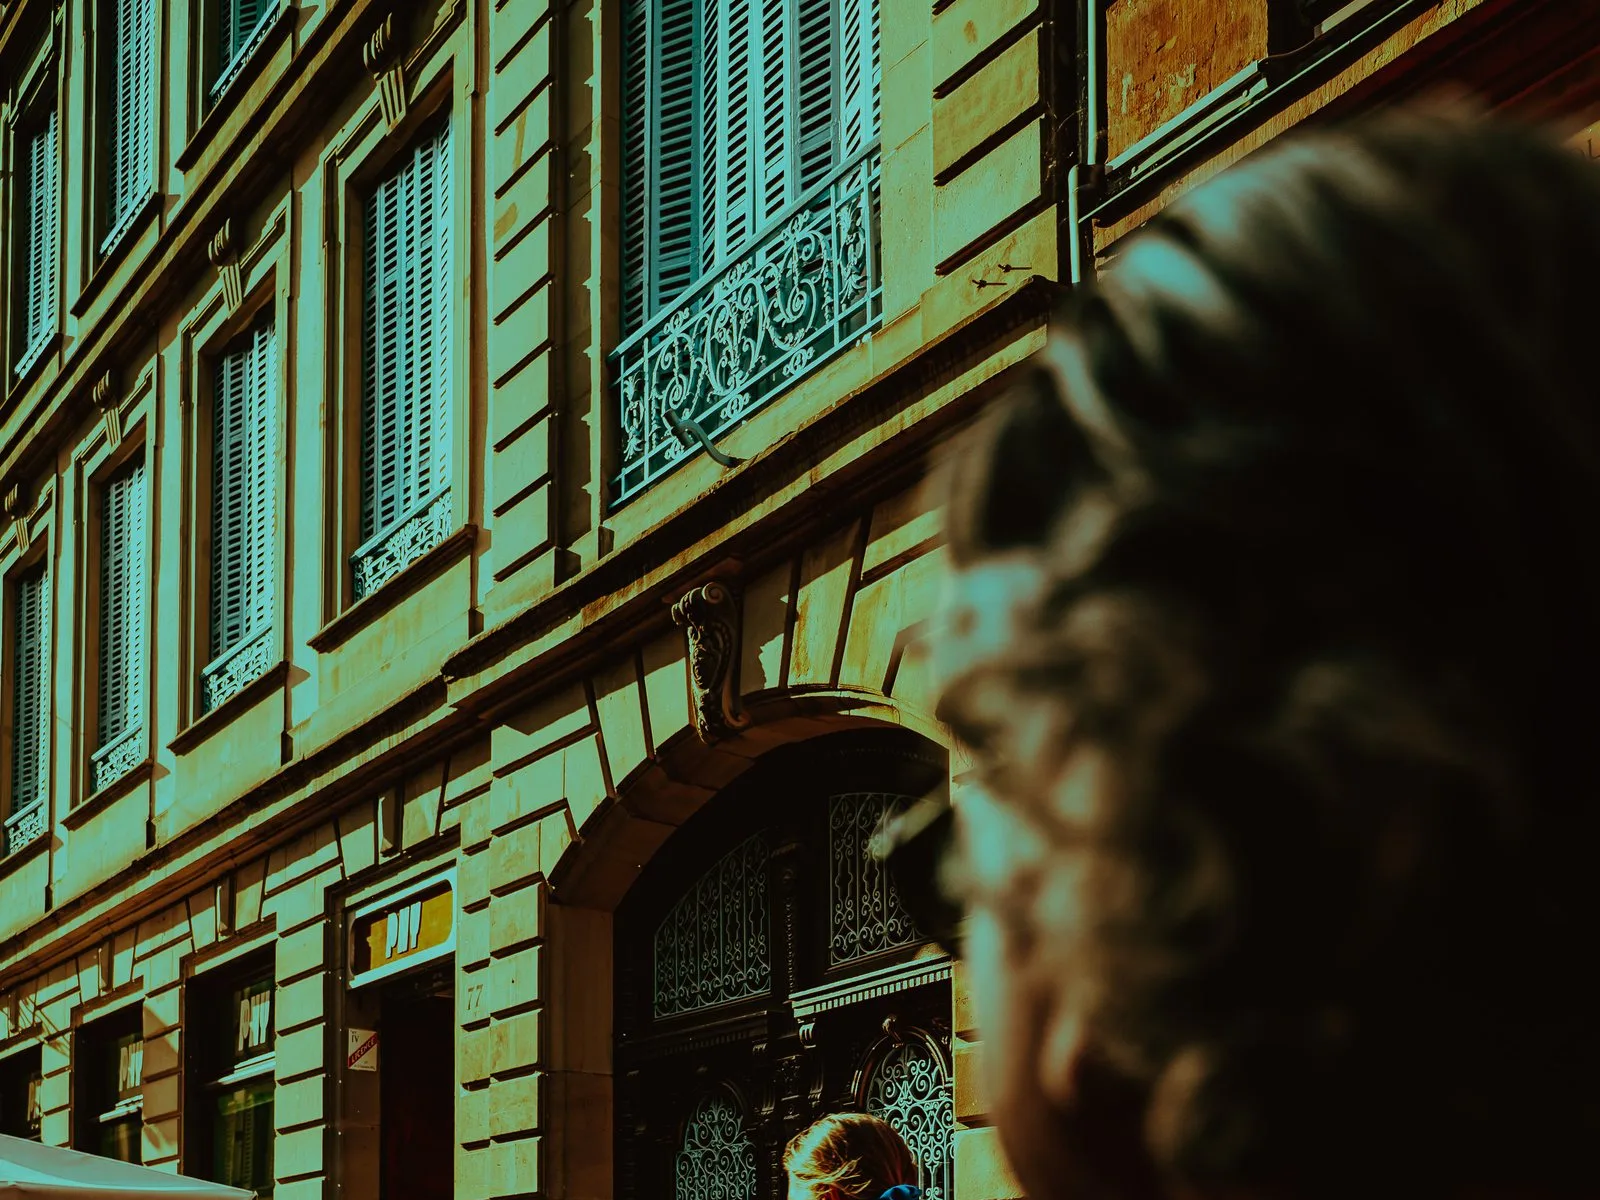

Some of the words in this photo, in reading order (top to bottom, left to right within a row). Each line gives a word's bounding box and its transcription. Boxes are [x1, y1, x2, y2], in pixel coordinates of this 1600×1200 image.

[385, 901, 423, 959] PNY
[467, 984, 484, 1010] 77
[238, 989, 271, 1051] PNY
[352, 1036, 377, 1063] LICENCE
